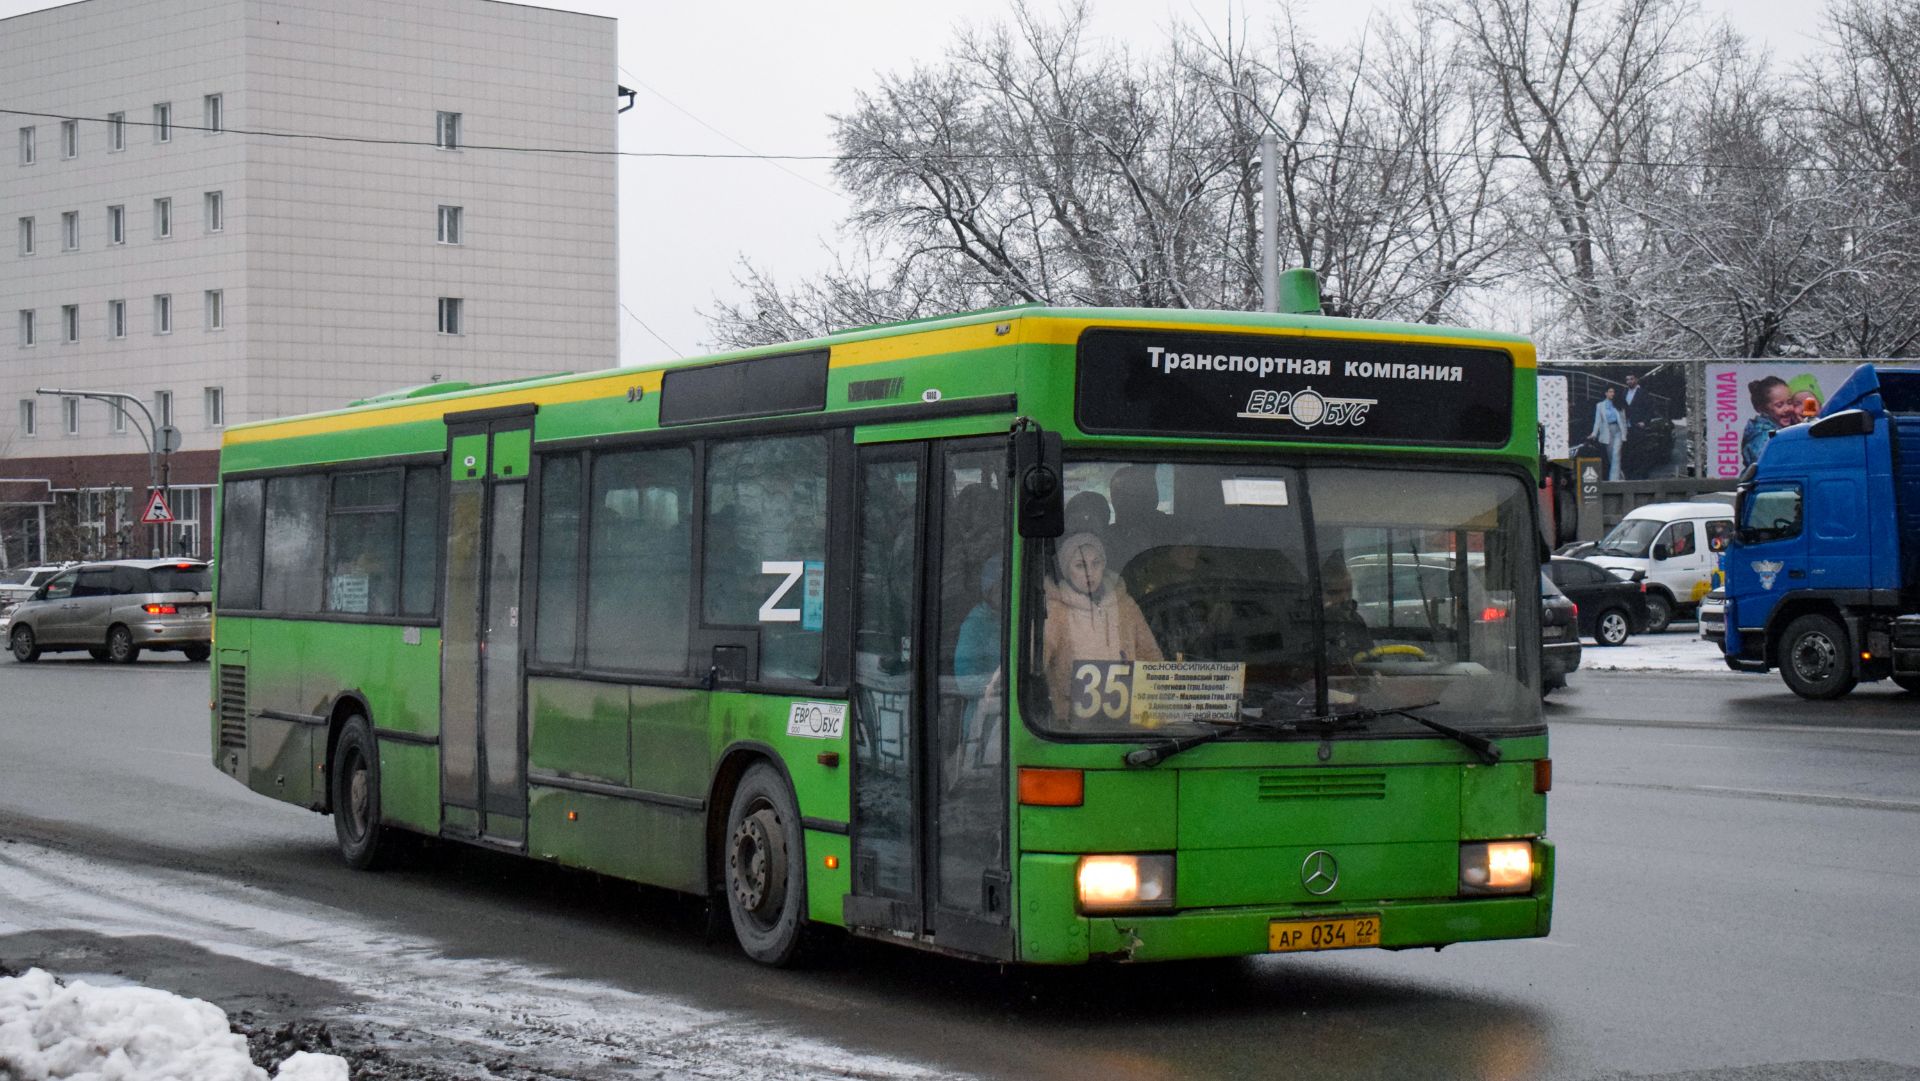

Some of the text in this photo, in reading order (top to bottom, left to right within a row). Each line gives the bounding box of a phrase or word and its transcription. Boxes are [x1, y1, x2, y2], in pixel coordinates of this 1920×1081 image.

[1146, 346, 1464, 382] Транспортная компания
[1716, 373, 1739, 480] СЕНЬ-ЗИМА
[759, 561, 804, 621] Z
[1074, 663, 1131, 719] 35
[1311, 924, 1345, 945] 034
[1357, 921, 1373, 936] 22
